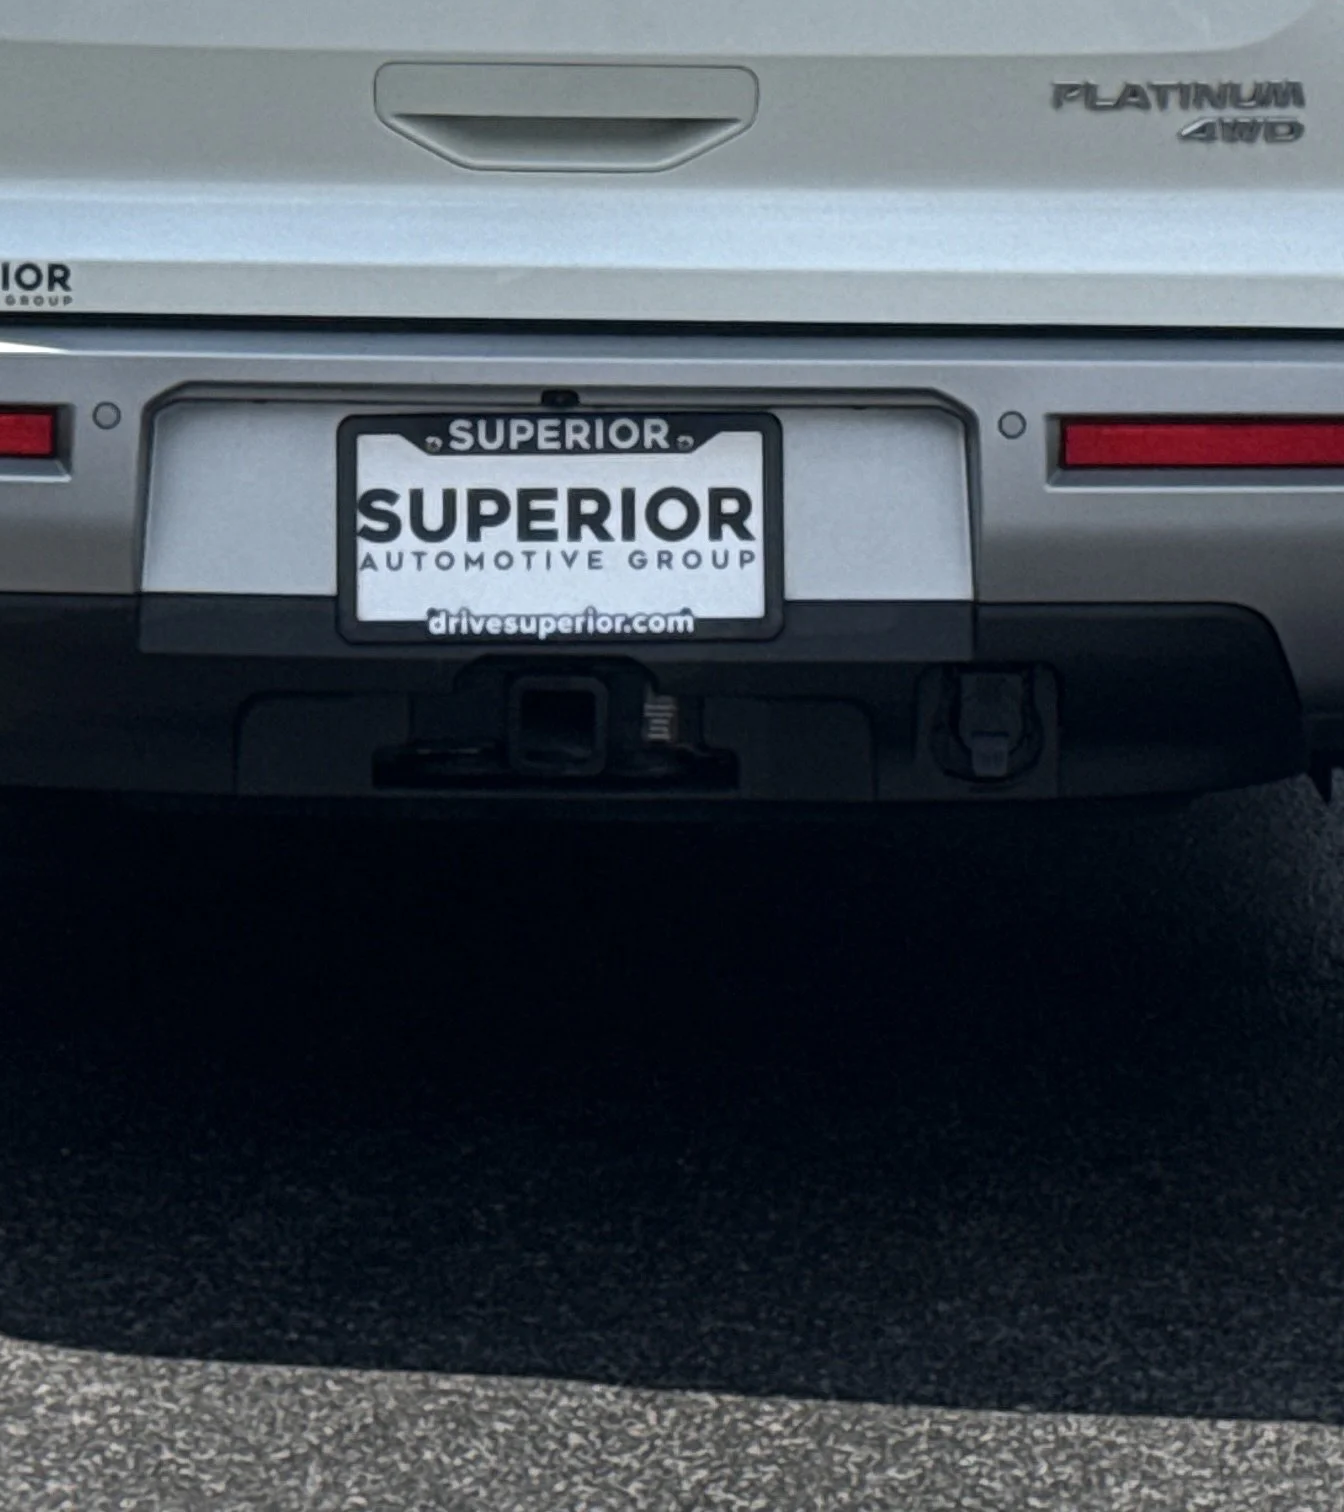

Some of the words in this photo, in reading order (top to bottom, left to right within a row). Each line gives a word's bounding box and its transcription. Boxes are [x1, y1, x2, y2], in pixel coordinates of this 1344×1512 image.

[1052, 81, 1305, 110] PLATINUM
[1176, 117, 1305, 143] 4WD
[5, 295, 73, 306] GROUP
[448, 419, 670, 451] SUPERIOR
[357, 487, 756, 543] SUPERIOR
[360, 551, 604, 572] AUTOMOTIVE
[628, 550, 756, 570] GROUP
[428, 607, 695, 639] drivesuperior.com
